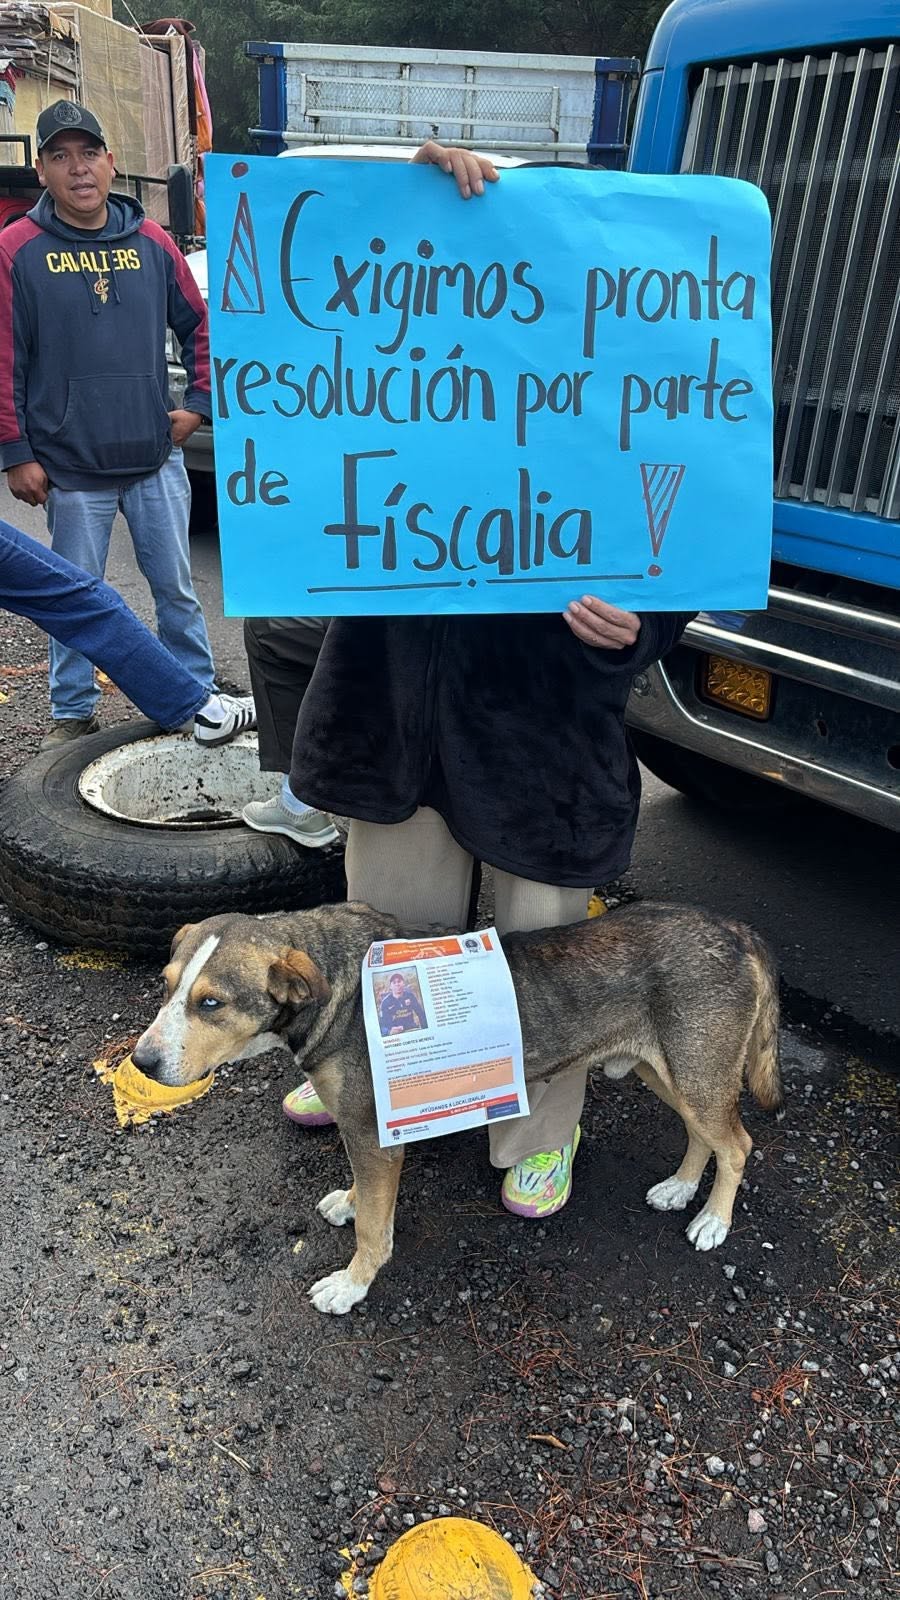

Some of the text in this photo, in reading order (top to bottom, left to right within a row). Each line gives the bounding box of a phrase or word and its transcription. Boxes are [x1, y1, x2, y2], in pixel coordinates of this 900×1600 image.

[46, 248, 141, 273] CAVALIERS
[583, 235, 757, 359] pronta
[213, 336, 753, 451] resolución por parte
[227, 439, 290, 506] de
